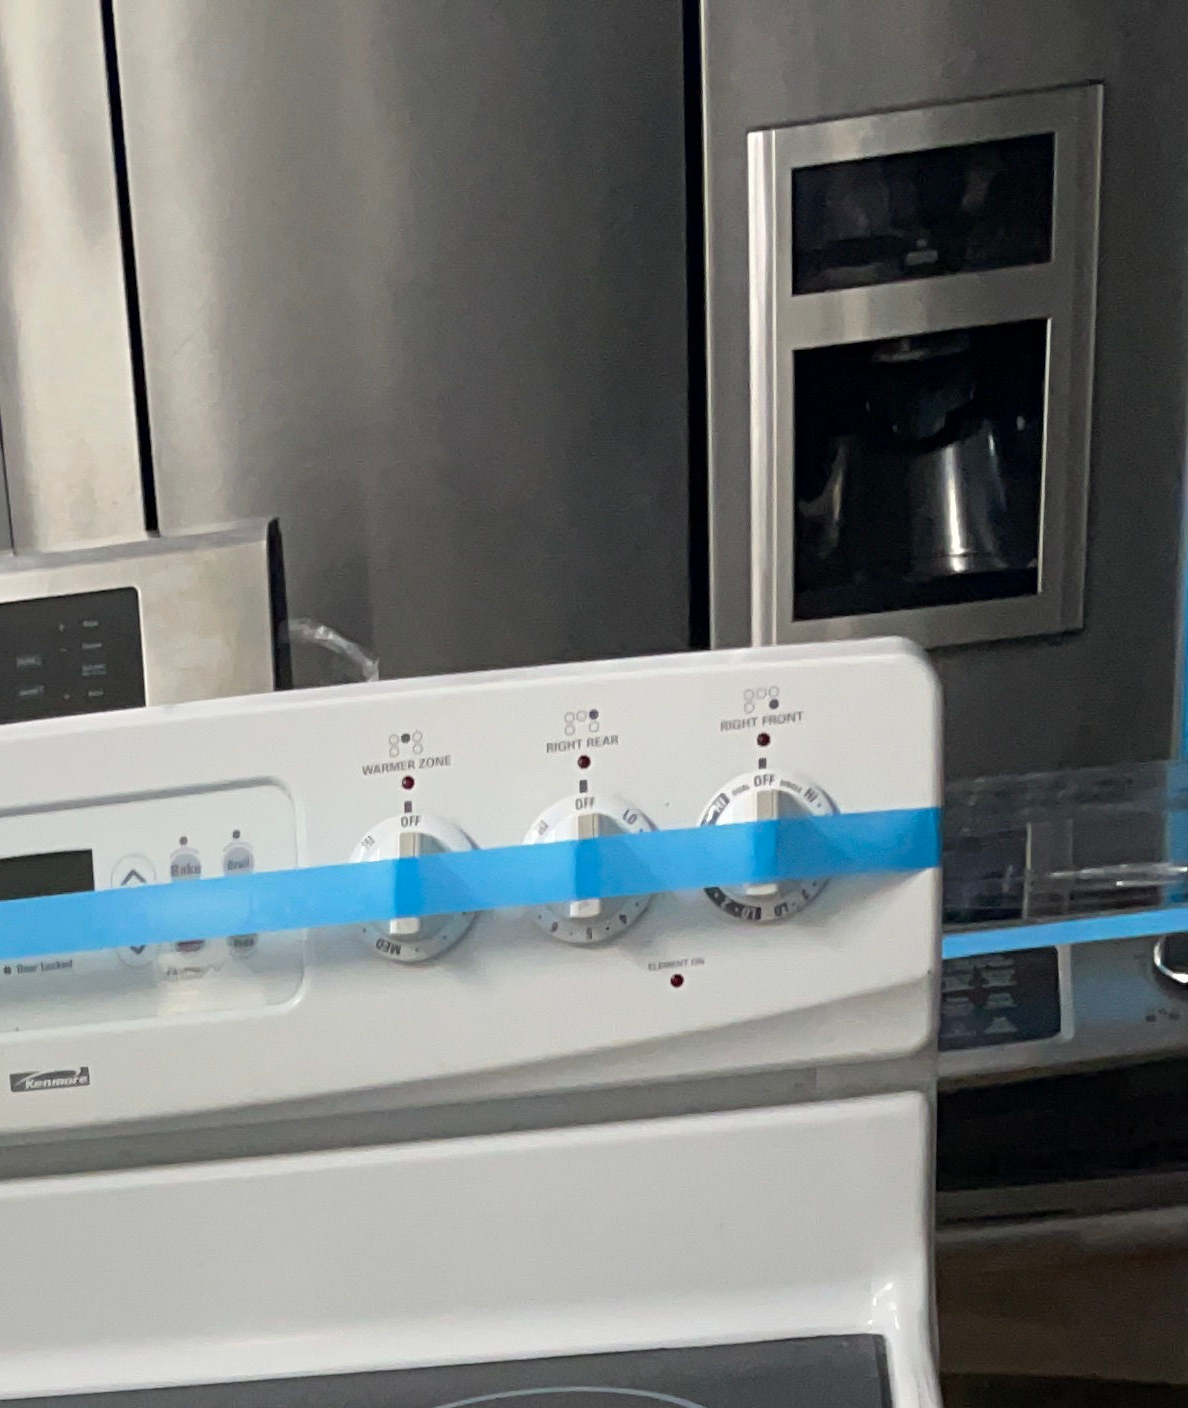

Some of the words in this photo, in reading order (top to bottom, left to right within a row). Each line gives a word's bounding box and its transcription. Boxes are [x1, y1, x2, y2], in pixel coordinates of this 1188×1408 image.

[720, 717, 758, 732] RIGHT
[762, 711, 804, 726] FRONT
[546, 738, 583, 753] RIGHT
[586, 734, 619, 749] REAR
[362, 759, 415, 776] WARMER
[418, 754, 451, 769] ZONE
[753, 774, 775, 788] OFF
[574, 796, 595, 811] OFF
[400, 814, 422, 829] OFF
[622, 807, 638, 825] LO
[171, 863, 202, 878] Bake
[375, 938, 403, 956] MED
[20, 1073, 89, 1090] Kenmore
